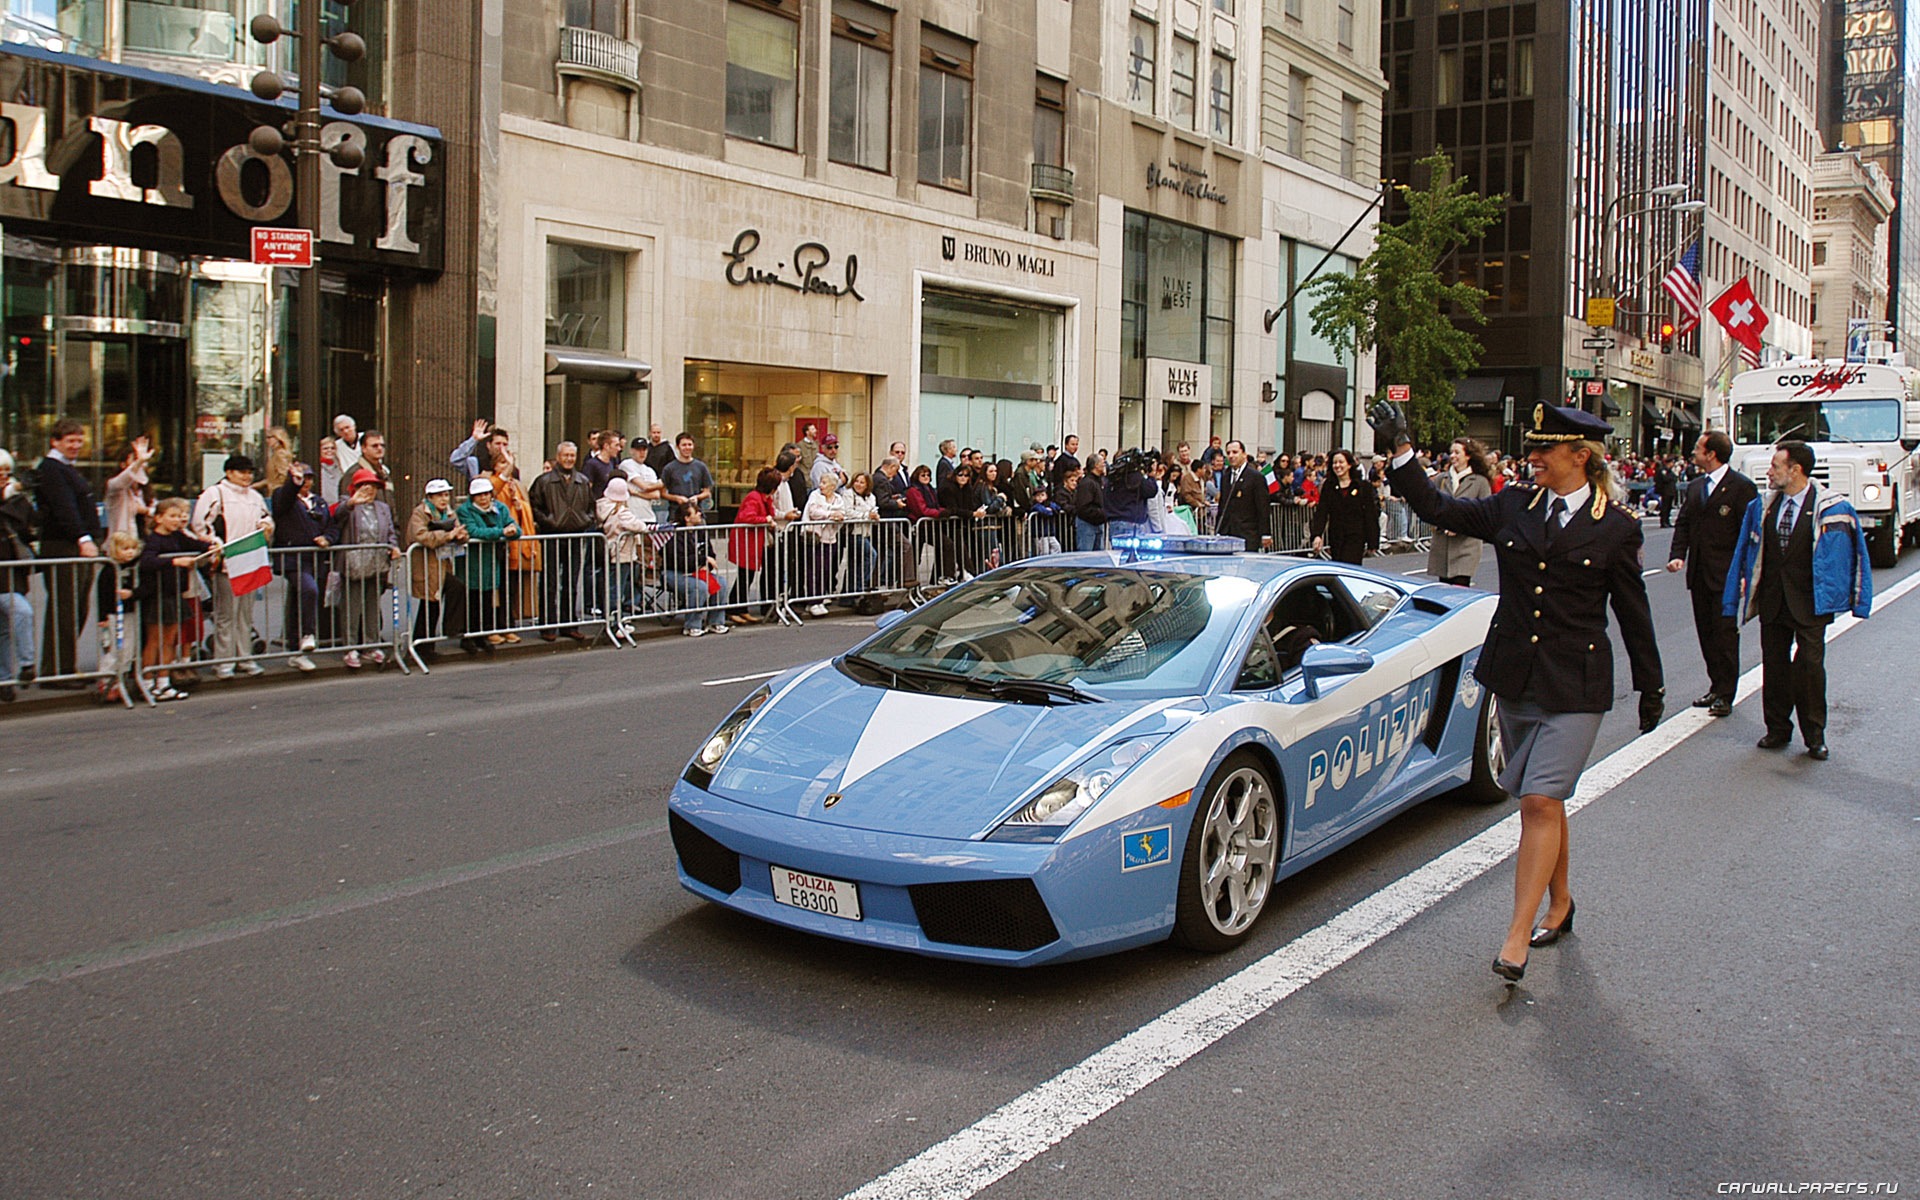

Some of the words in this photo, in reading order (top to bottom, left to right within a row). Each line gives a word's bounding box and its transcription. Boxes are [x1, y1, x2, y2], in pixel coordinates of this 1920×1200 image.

[256, 231, 268, 240] NO
[271, 232, 308, 242] STANDING
[262, 241, 302, 252] ANYTIME
[964, 243, 1011, 268] BRUNO
[1016, 253, 1055, 277] MAGLI
[1162, 276, 1192, 295] NINE
[1161, 292, 1192, 310] WEST
[1168, 366, 1198, 381] NINE
[1777, 374, 1814, 387] COP
[1168, 380, 1198, 397] WEST
[1304, 687, 1432, 810] POLIZIA
[788, 872, 836, 894] POLIZIA
[790, 887, 839, 915] E8300
